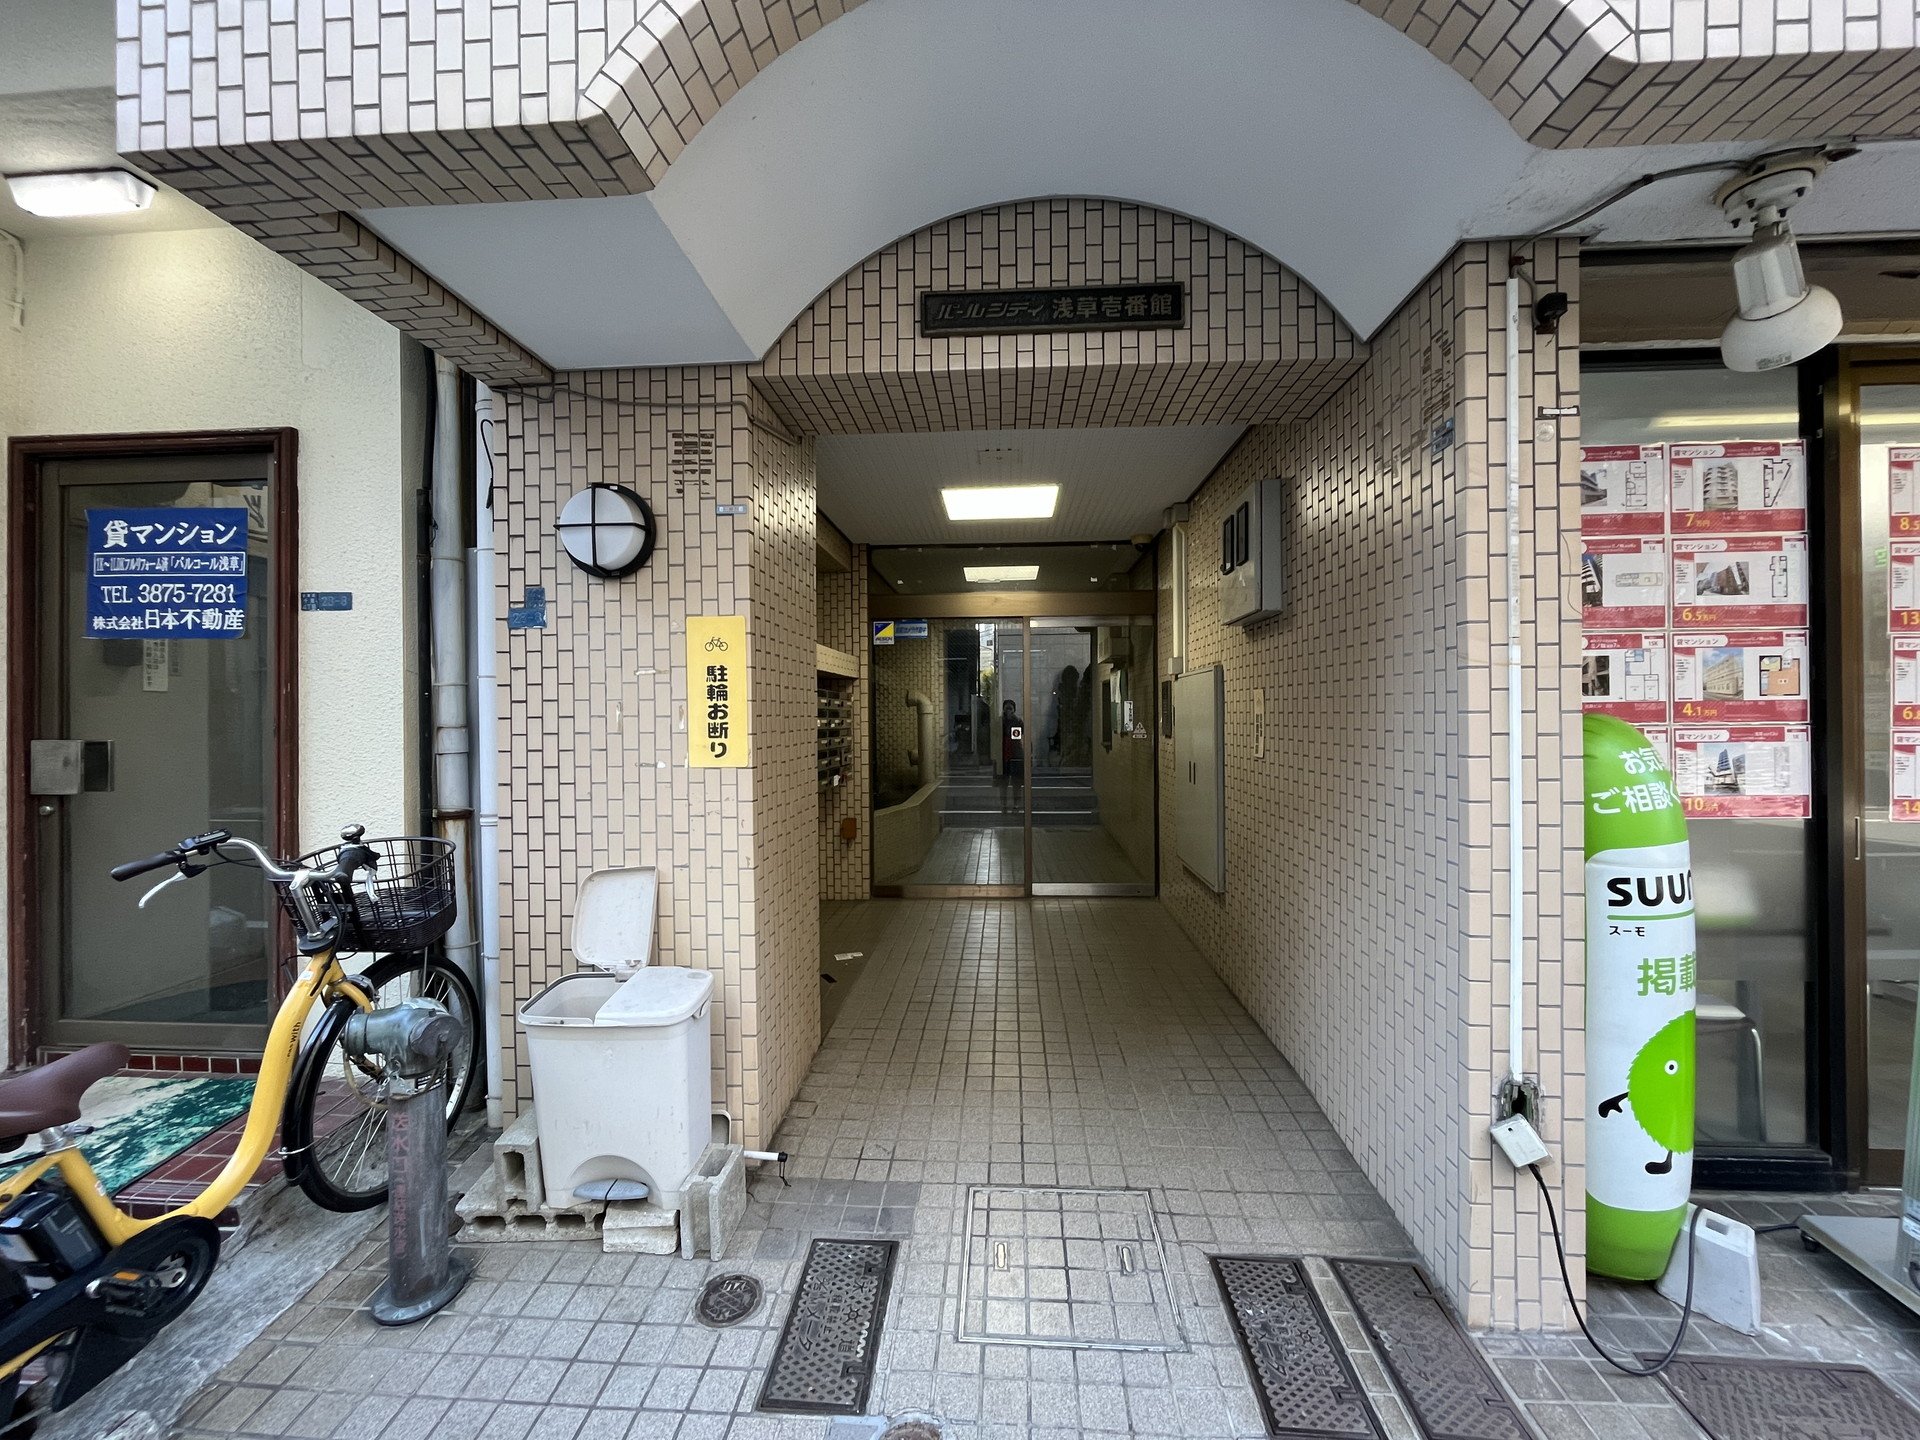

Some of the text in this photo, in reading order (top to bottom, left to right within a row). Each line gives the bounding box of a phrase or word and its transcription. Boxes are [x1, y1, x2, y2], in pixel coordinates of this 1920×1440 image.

[1051, 293, 1172, 320] 浅草壱番館
[103, 520, 237, 548] 貸マンション
[101, 584, 236, 604] TEL 3875-7281
[93, 608, 245, 630] 株式会社日本不動産
[706, 665, 729, 759] 駐輪お断り
[1609, 925, 1646, 937] スーモ
